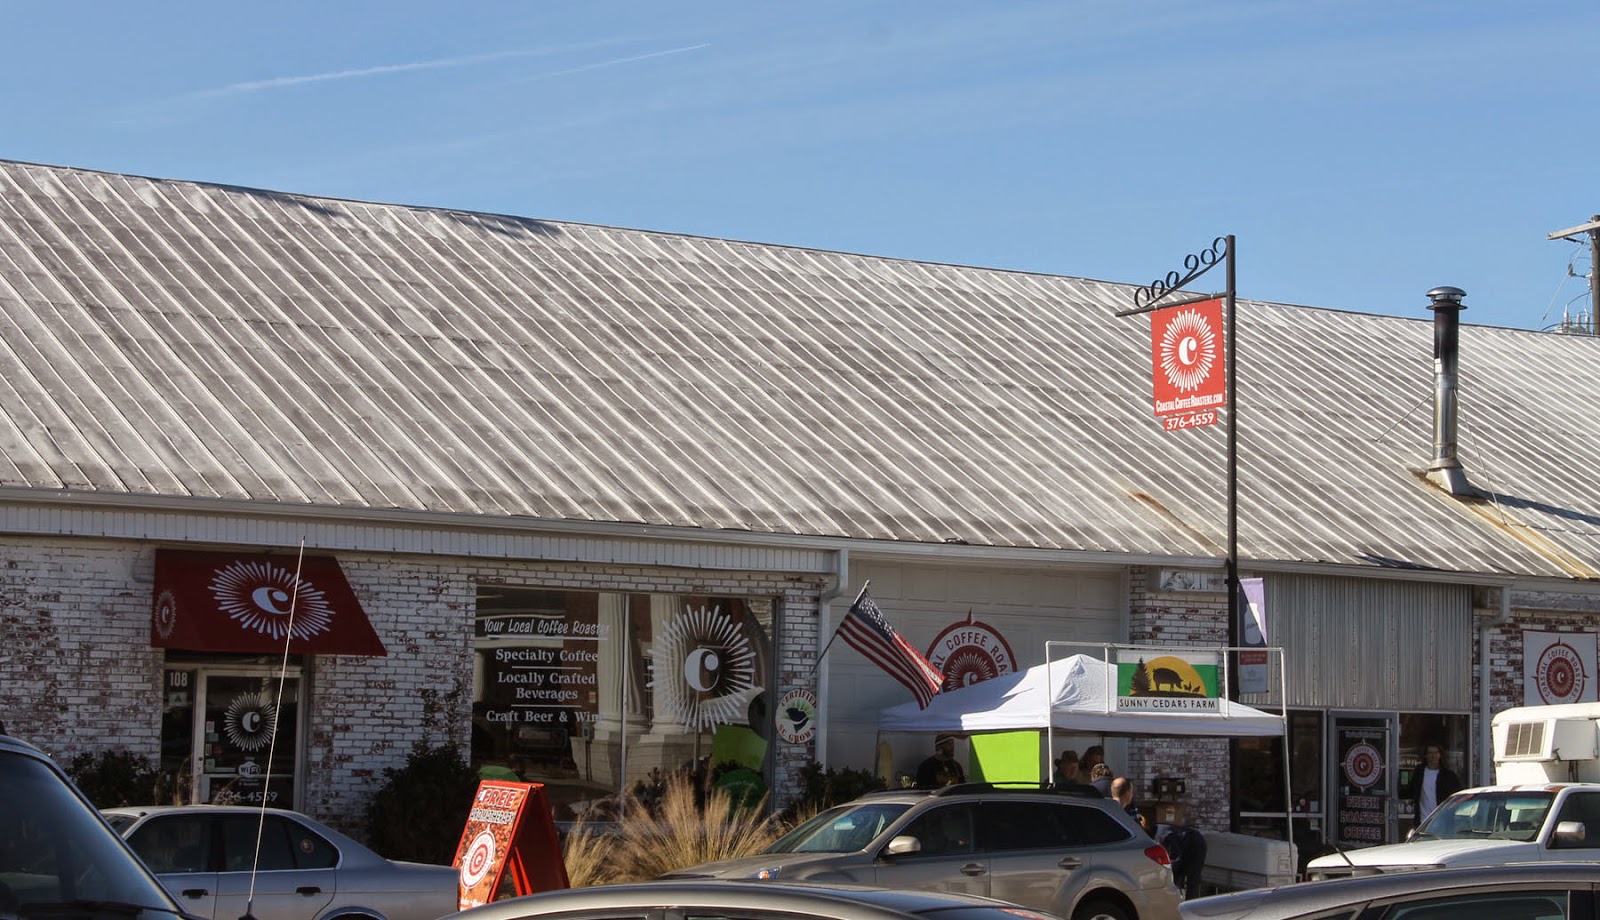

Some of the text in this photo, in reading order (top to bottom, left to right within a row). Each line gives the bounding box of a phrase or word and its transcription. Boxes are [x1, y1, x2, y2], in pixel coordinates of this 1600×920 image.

[1166, 412, 1214, 429] 376-4559
[484, 618, 504, 633] Your
[508, 619, 535, 633] Local
[537, 620, 569, 634] Coffee
[946, 632, 987, 650] COFFEE
[495, 649, 598, 663] Specialty Coffee
[170, 672, 188, 687] 108
[497, 672, 596, 686] Locally Crafted
[515, 687, 578, 702] Beverages
[1119, 699, 1216, 709] SUNNY CEDARS FARM
[486, 710, 519, 722] Craft
[525, 711, 554, 722] Beer
[558, 711, 568, 722] &
[481, 788, 517, 808] FREE
